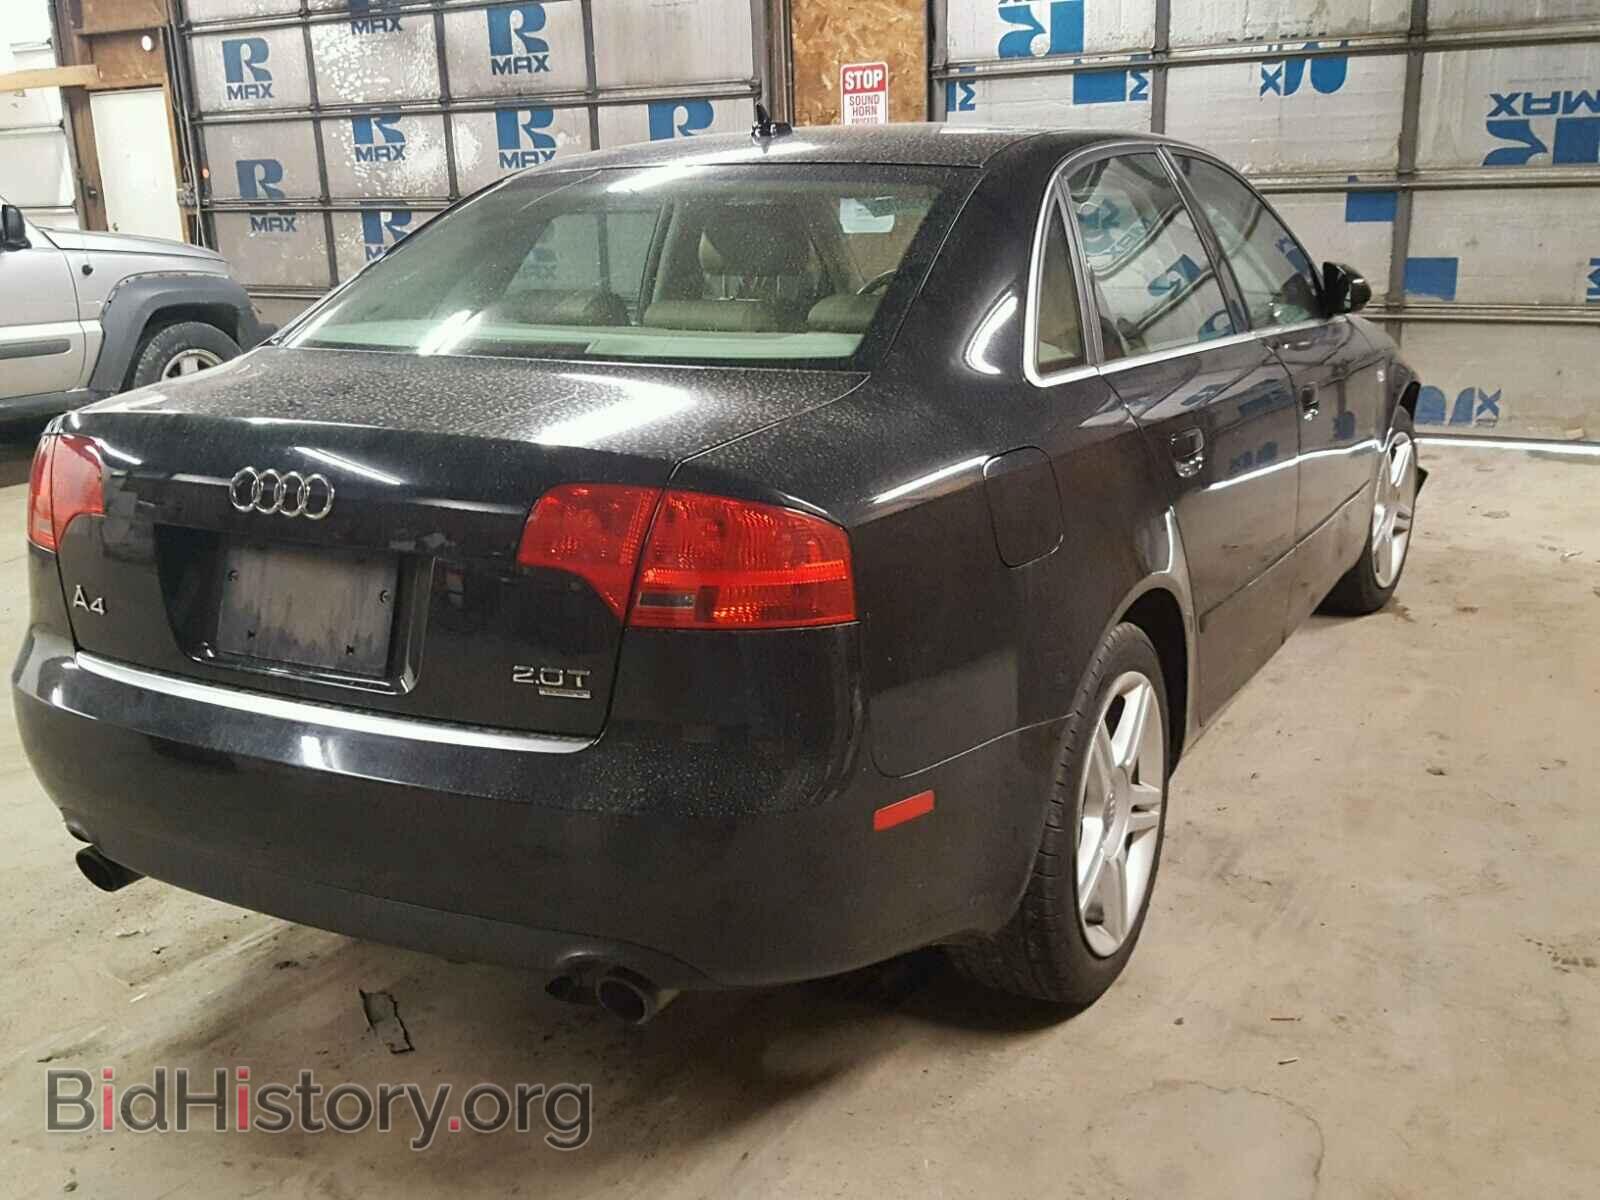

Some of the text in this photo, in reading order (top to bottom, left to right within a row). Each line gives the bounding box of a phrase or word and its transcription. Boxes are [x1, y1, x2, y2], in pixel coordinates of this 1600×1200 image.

[351, 18, 403, 34] MAX
[223, 37, 272, 83] R
[491, 54, 550, 75] MAX
[845, 70, 883, 90] STOP
[227, 83, 273, 100] MAX
[849, 95, 880, 106] SOUND
[852, 106, 877, 117] HORN
[356, 145, 406, 162] MAX
[251, 217, 297, 232] MAX
[73, 584, 105, 615] A4
[513, 665, 590, 687] 2.0T
